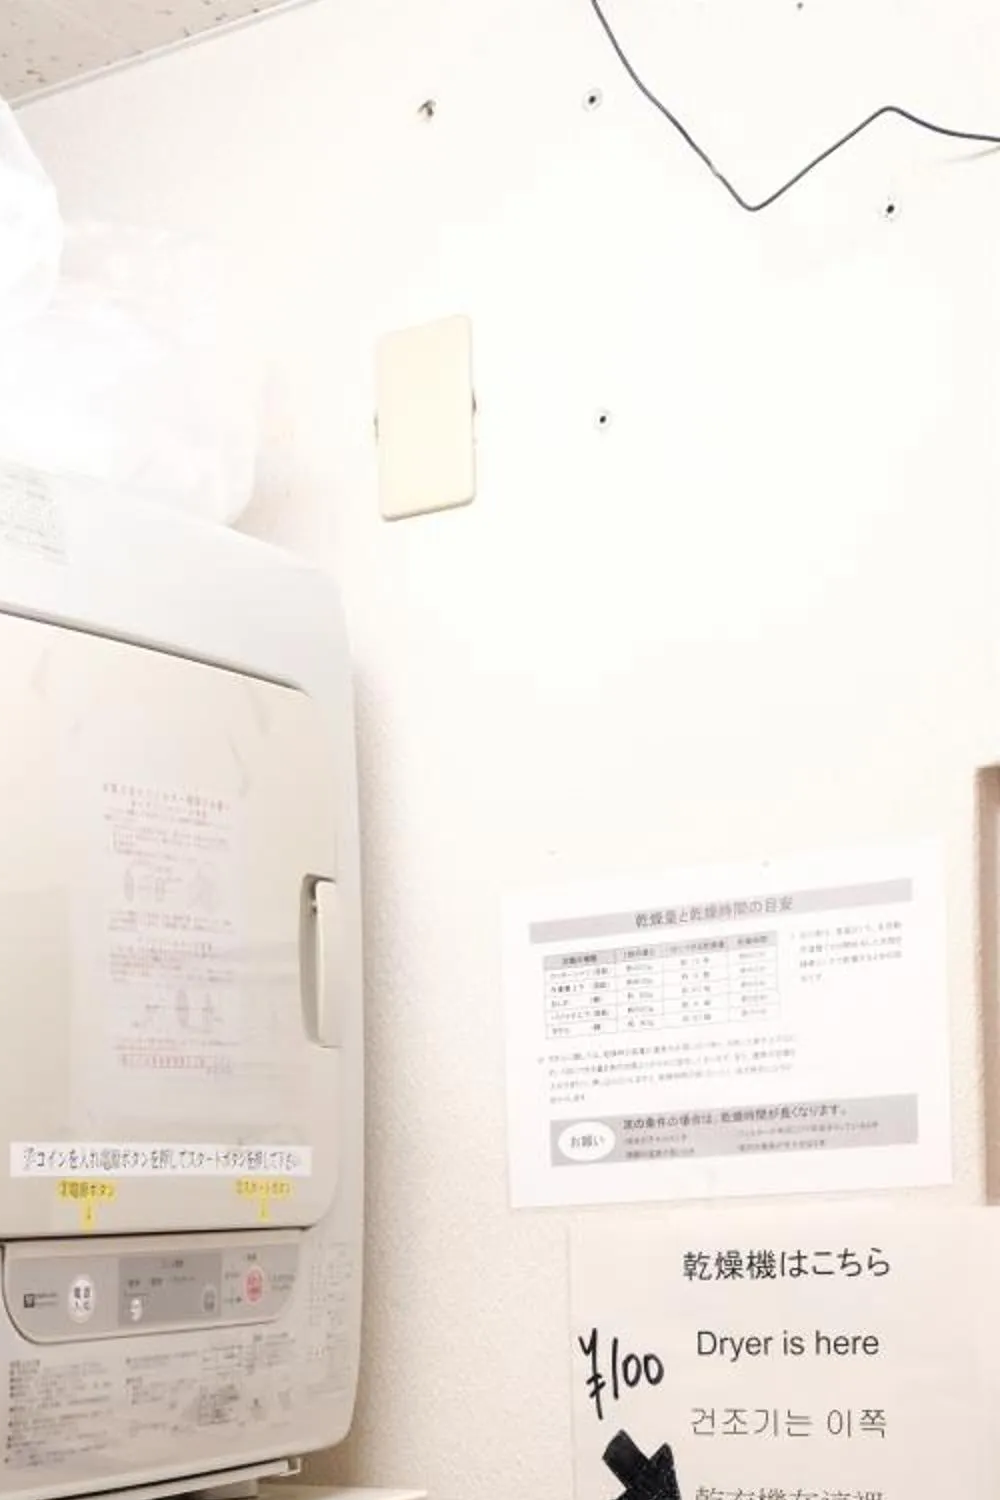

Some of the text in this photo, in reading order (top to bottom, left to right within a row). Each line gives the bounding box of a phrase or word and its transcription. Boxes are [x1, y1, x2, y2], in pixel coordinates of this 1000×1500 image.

[682, 1248, 891, 1281] 乾燥機はこちら
[697, 1330, 880, 1362] Dryer is here
[578, 1328, 665, 1421] ¥100
[689, 1407, 888, 1439] 건조기는 이쪽
